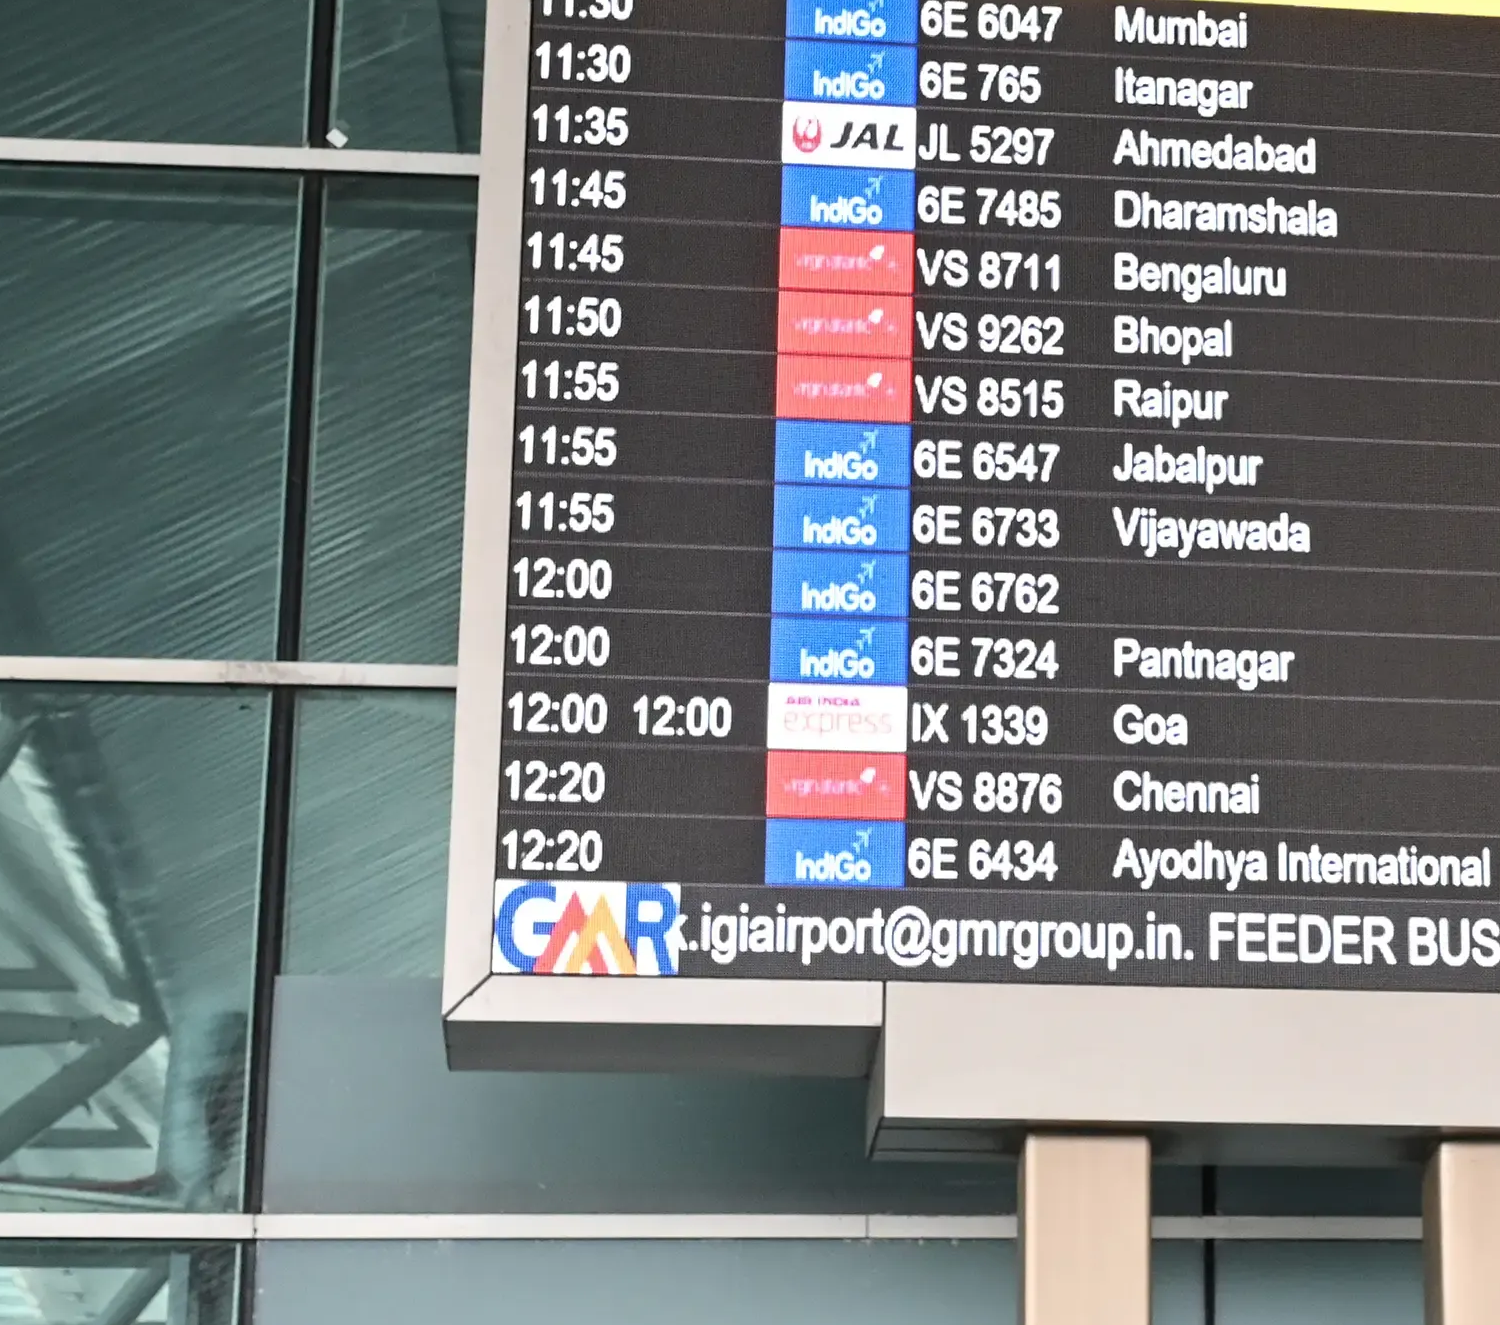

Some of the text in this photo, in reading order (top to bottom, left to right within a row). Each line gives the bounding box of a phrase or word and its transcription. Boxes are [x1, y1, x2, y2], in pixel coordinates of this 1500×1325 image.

[921, 0, 968, 38] 6E
[978, 3, 1062, 42] 6047
[1115, 6, 1247, 48] Mumbai
[536, 41, 631, 83] 11:30
[920, 61, 967, 100] 6E
[978, 64, 1041, 103] 765
[1115, 67, 1253, 117] Itanagar
[533, 104, 628, 145] 11:35
[830, 121, 904, 151] JAL
[919, 124, 961, 163] JL
[970, 125, 1054, 165] 5297
[1113, 129, 1316, 174] Ahmedabad
[530, 167, 626, 209] 11:45
[918, 186, 965, 224] 6E
[976, 188, 1061, 228] 7485
[1115, 190, 1337, 237] Dharamshala
[527, 231, 623, 273] 11:45
[917, 248, 969, 287] VS
[979, 251, 1060, 292] 8711
[1114, 252, 1286, 303] Bengaluru
[525, 295, 621, 337] 11:50
[916, 311, 968, 351] VS
[978, 314, 1064, 355] 9262
[1114, 315, 1232, 365] Bhopal
[522, 360, 619, 401] 11:55
[915, 375, 967, 415] VS
[977, 377, 1064, 418] 8515
[1114, 379, 1229, 428] Raipur
[519, 425, 617, 466] 11:55
[914, 439, 962, 479] 6E
[973, 442, 1060, 482] 6547
[1113, 443, 1263, 494] Jabalpur
[516, 491, 614, 533] 11:55
[913, 505, 962, 545] 6E
[972, 507, 1060, 548] 6733
[1112, 507, 1310, 558] Vijayawada
[513, 557, 612, 599] 12:00
[912, 570, 961, 610] 6E
[971, 572, 1059, 614] 6762
[511, 624, 610, 666] 12:00
[911, 636, 960, 677] 6E
[971, 637, 1059, 679] 7324
[1114, 638, 1295, 691] Pantnagar
[508, 691, 607, 733] 12:00
[633, 695, 732, 737] 12:00
[911, 702, 949, 743] IX
[961, 704, 1048, 745] 1339
[1113, 704, 1188, 745] Goa
[505, 760, 605, 803] 12:20
[909, 770, 963, 811] VS
[973, 772, 1062, 814] 8876
[1113, 770, 1259, 814] Chennai
[502, 829, 602, 871] 12:20
[908, 838, 958, 879] 6E
[969, 839, 1058, 881] 6434
[1112, 838, 1267, 891] Ayodhya
[1278, 842, 1490, 887] International
[495, 882, 679, 974] GMR
[1209, 912, 1397, 965] FEEDER
